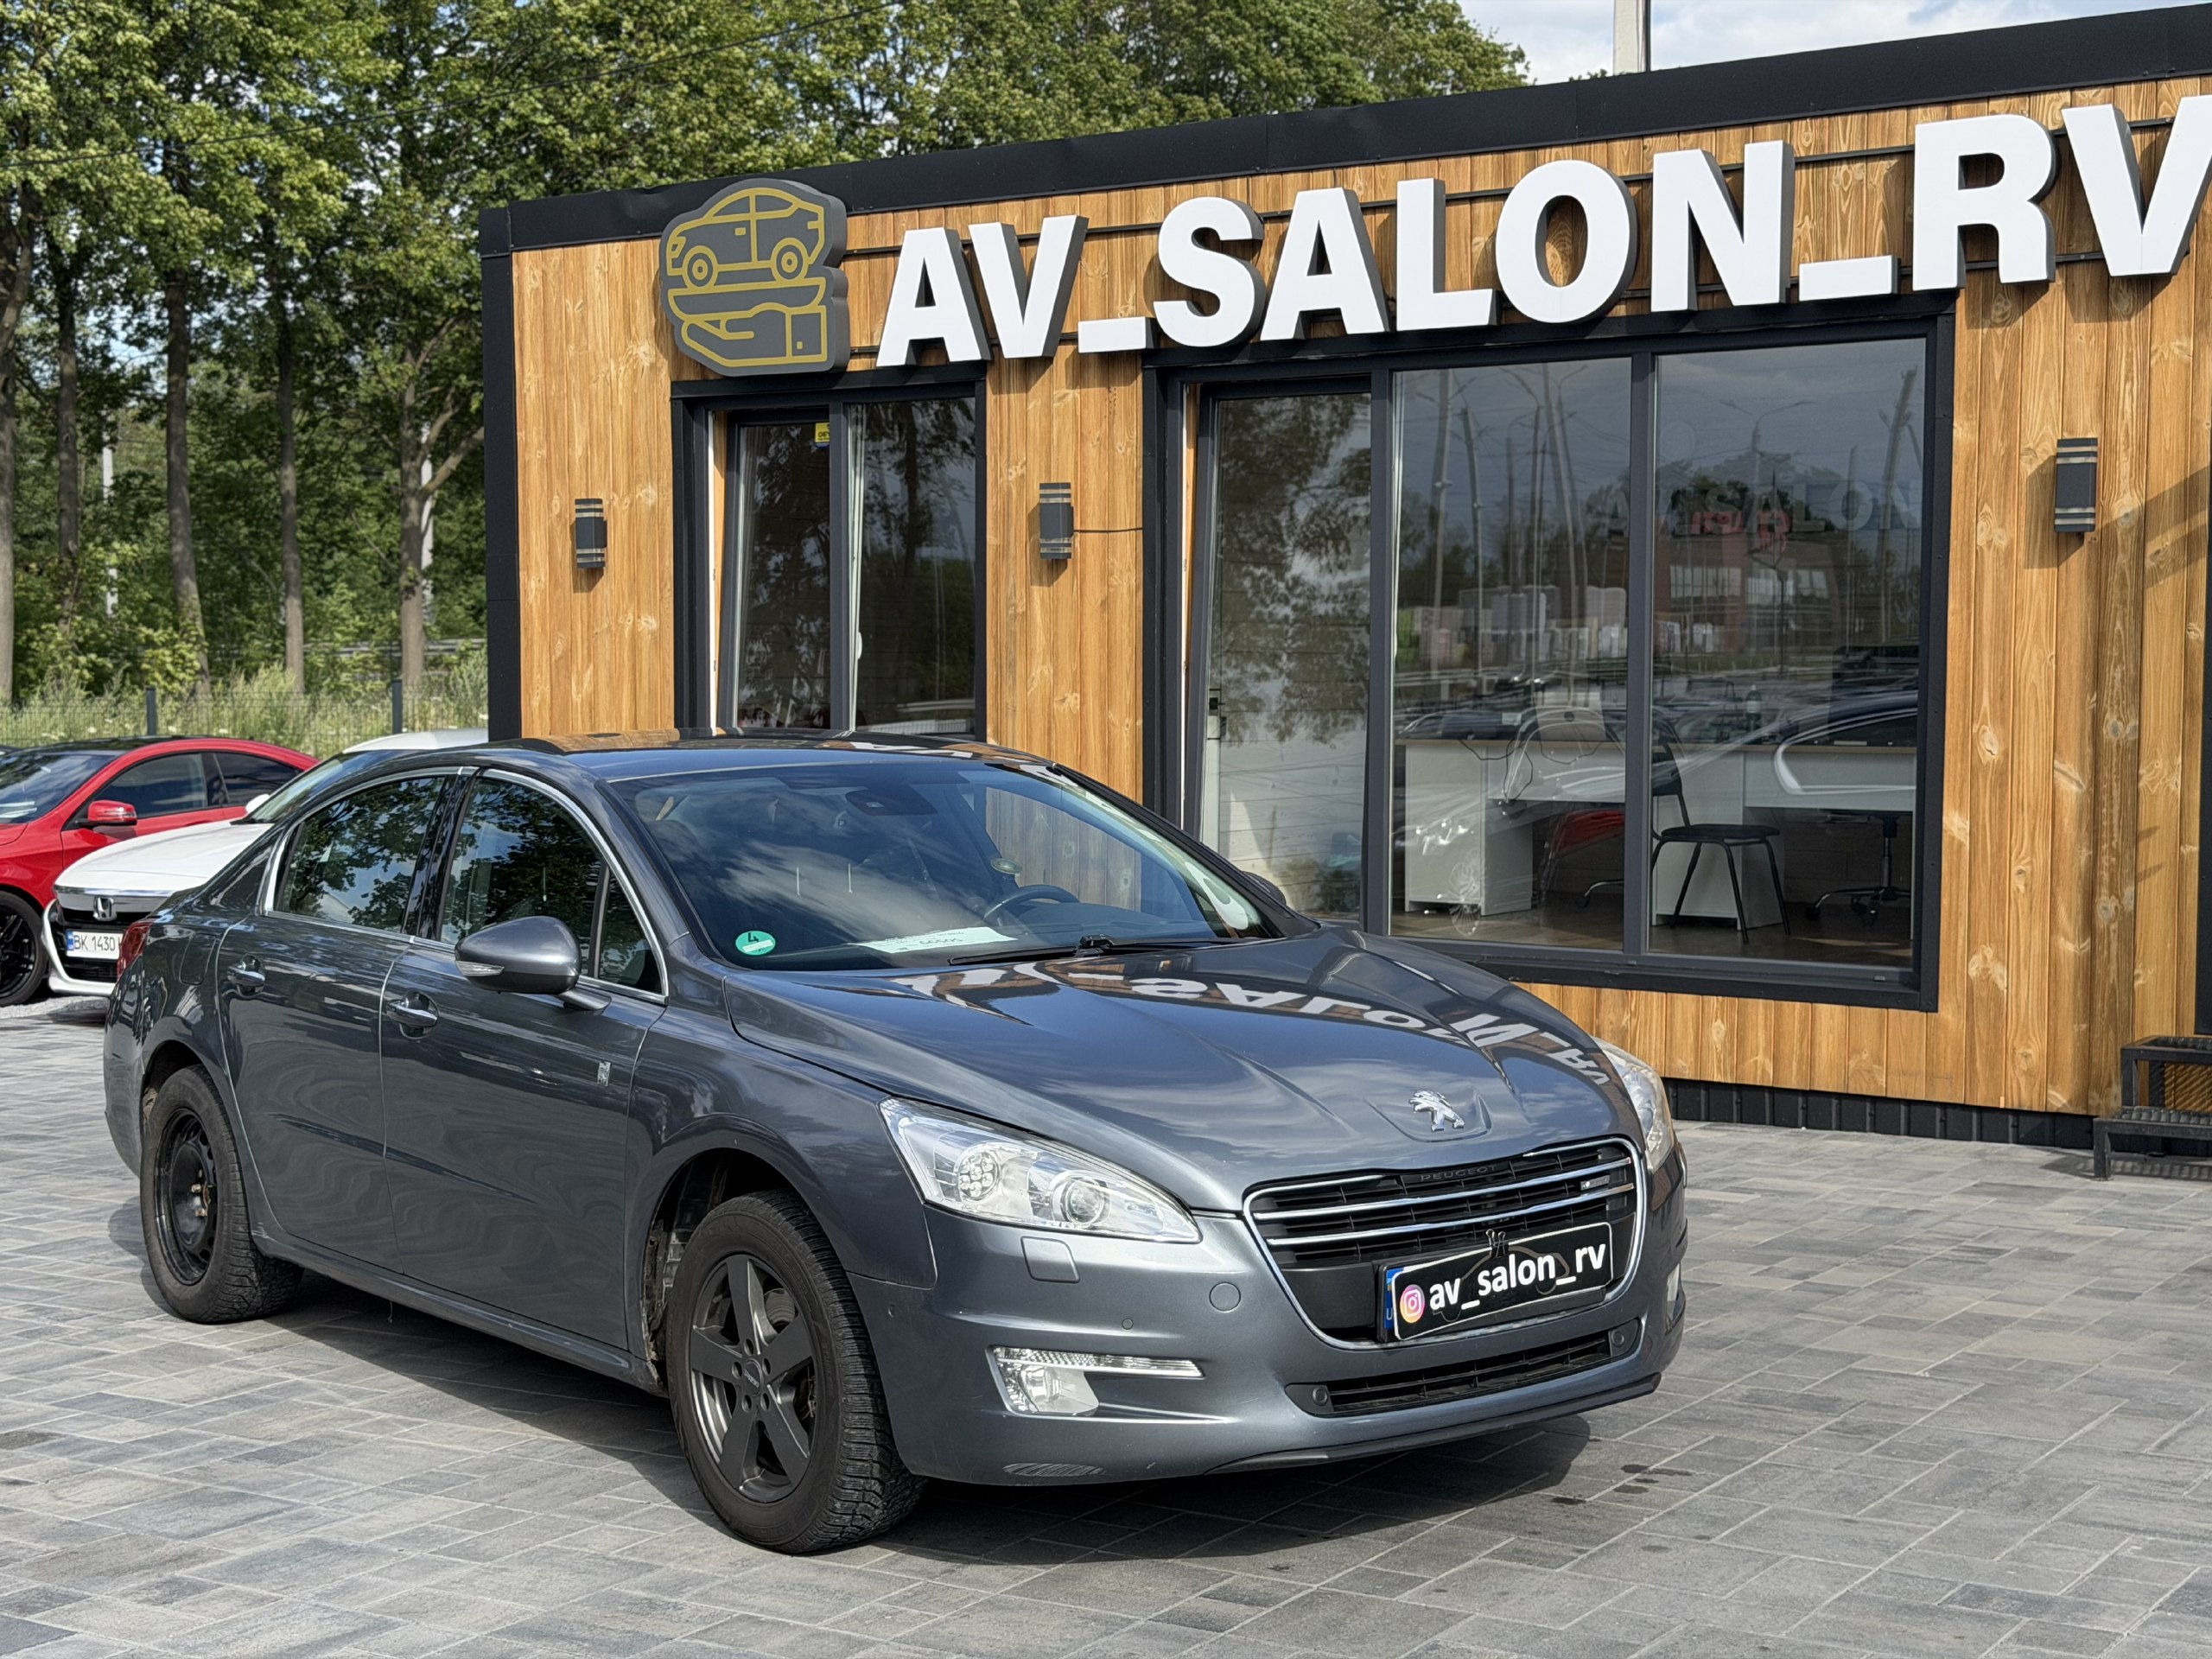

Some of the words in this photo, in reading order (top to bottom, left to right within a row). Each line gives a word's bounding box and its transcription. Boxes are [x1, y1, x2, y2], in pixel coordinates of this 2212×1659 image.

[876, 94, 2212, 368] AV_SALON_RV
[73, 935, 89, 950] BK
[91, 936, 116, 951] 1430
[1420, 1165, 1497, 1182] PEUGEOT
[1429, 1243, 1606, 1311] av_salon_rv
